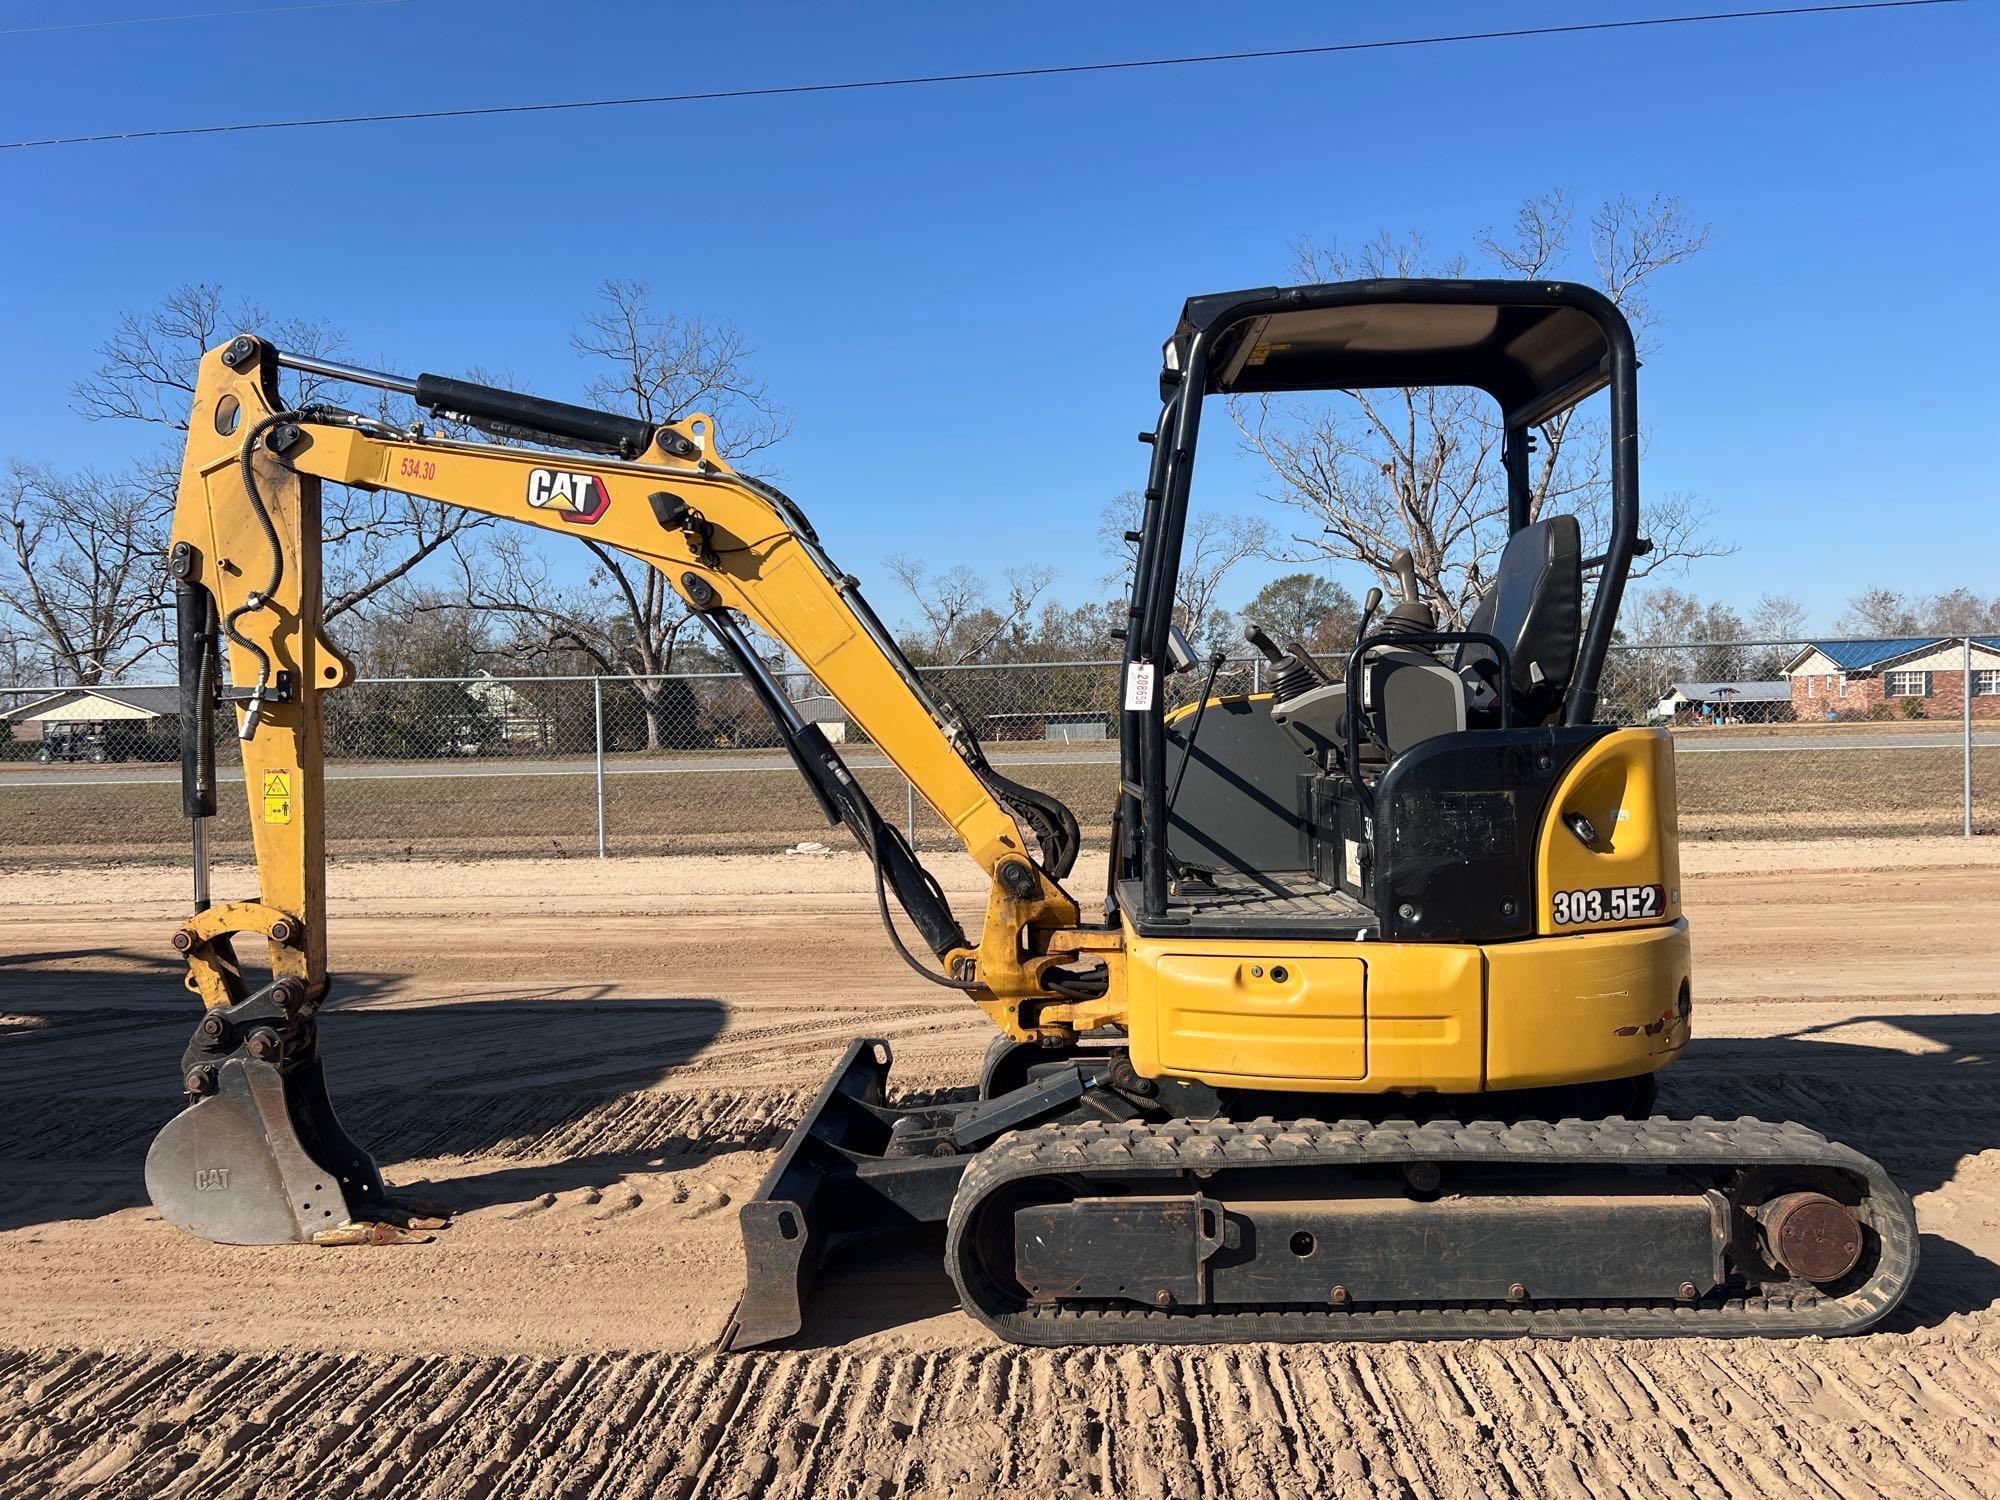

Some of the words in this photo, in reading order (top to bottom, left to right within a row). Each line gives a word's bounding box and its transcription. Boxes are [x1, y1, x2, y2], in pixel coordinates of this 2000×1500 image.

[401, 457, 436, 481] 534.30
[528, 469, 593, 513] CAT
[1554, 886, 1656, 924] 303.5E2
[195, 1168, 230, 1192] CAT
